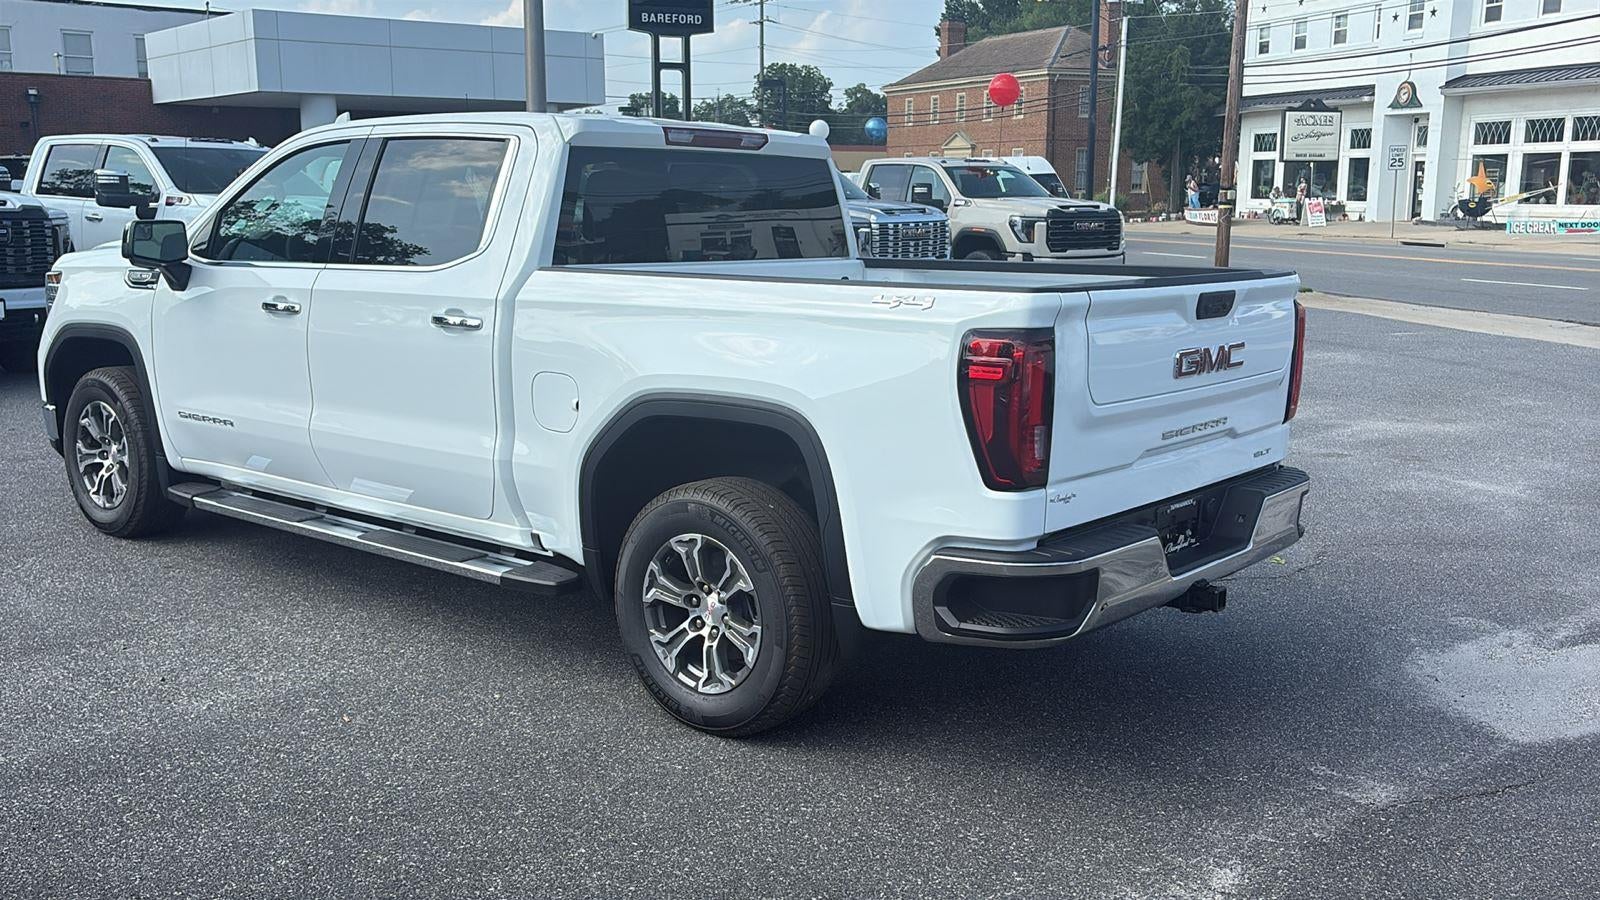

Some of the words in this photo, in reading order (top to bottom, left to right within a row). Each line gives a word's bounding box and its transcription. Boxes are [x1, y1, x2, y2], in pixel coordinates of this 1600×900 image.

[641, 12, 702, 25] BAREFORD
[1390, 158, 1405, 168] 25
[1510, 221, 1525, 234] ICE
[1526, 221, 1558, 234] CREAM
[1173, 341, 1245, 380] GMC
[178, 410, 235, 428] SIERRA
[1161, 416, 1228, 441] SIERRA
[1253, 447, 1272, 459] SLT
[711, 512, 768, 574] MICHELIN
